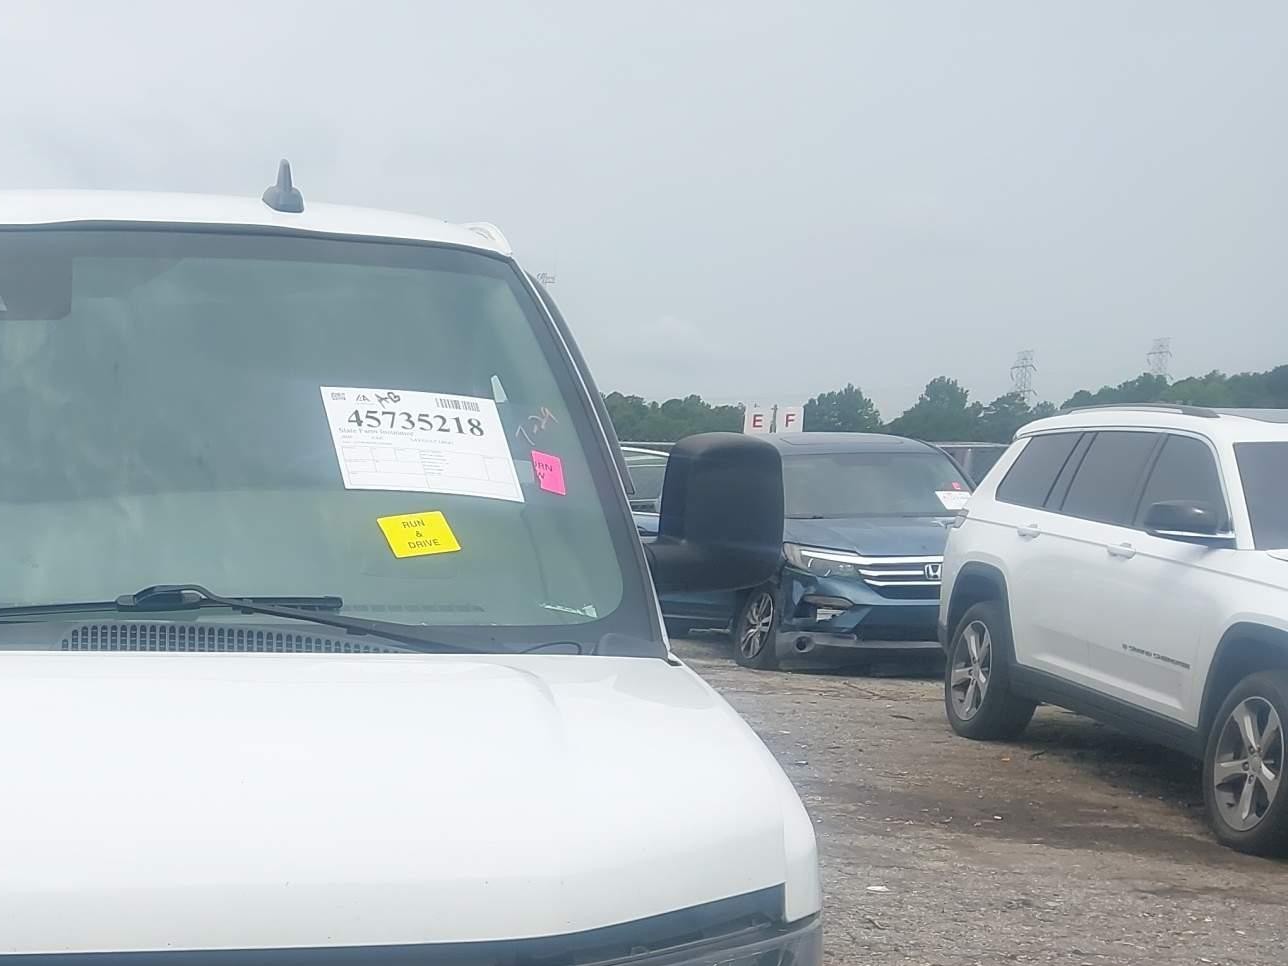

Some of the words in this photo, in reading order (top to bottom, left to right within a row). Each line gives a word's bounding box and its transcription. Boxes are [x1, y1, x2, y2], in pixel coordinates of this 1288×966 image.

[348, 409, 485, 437] 45735218
[752, 414, 763, 428] E
[785, 414, 795, 427] F
[401, 519, 425, 529] RUN
[408, 538, 441, 550] DRIVE
